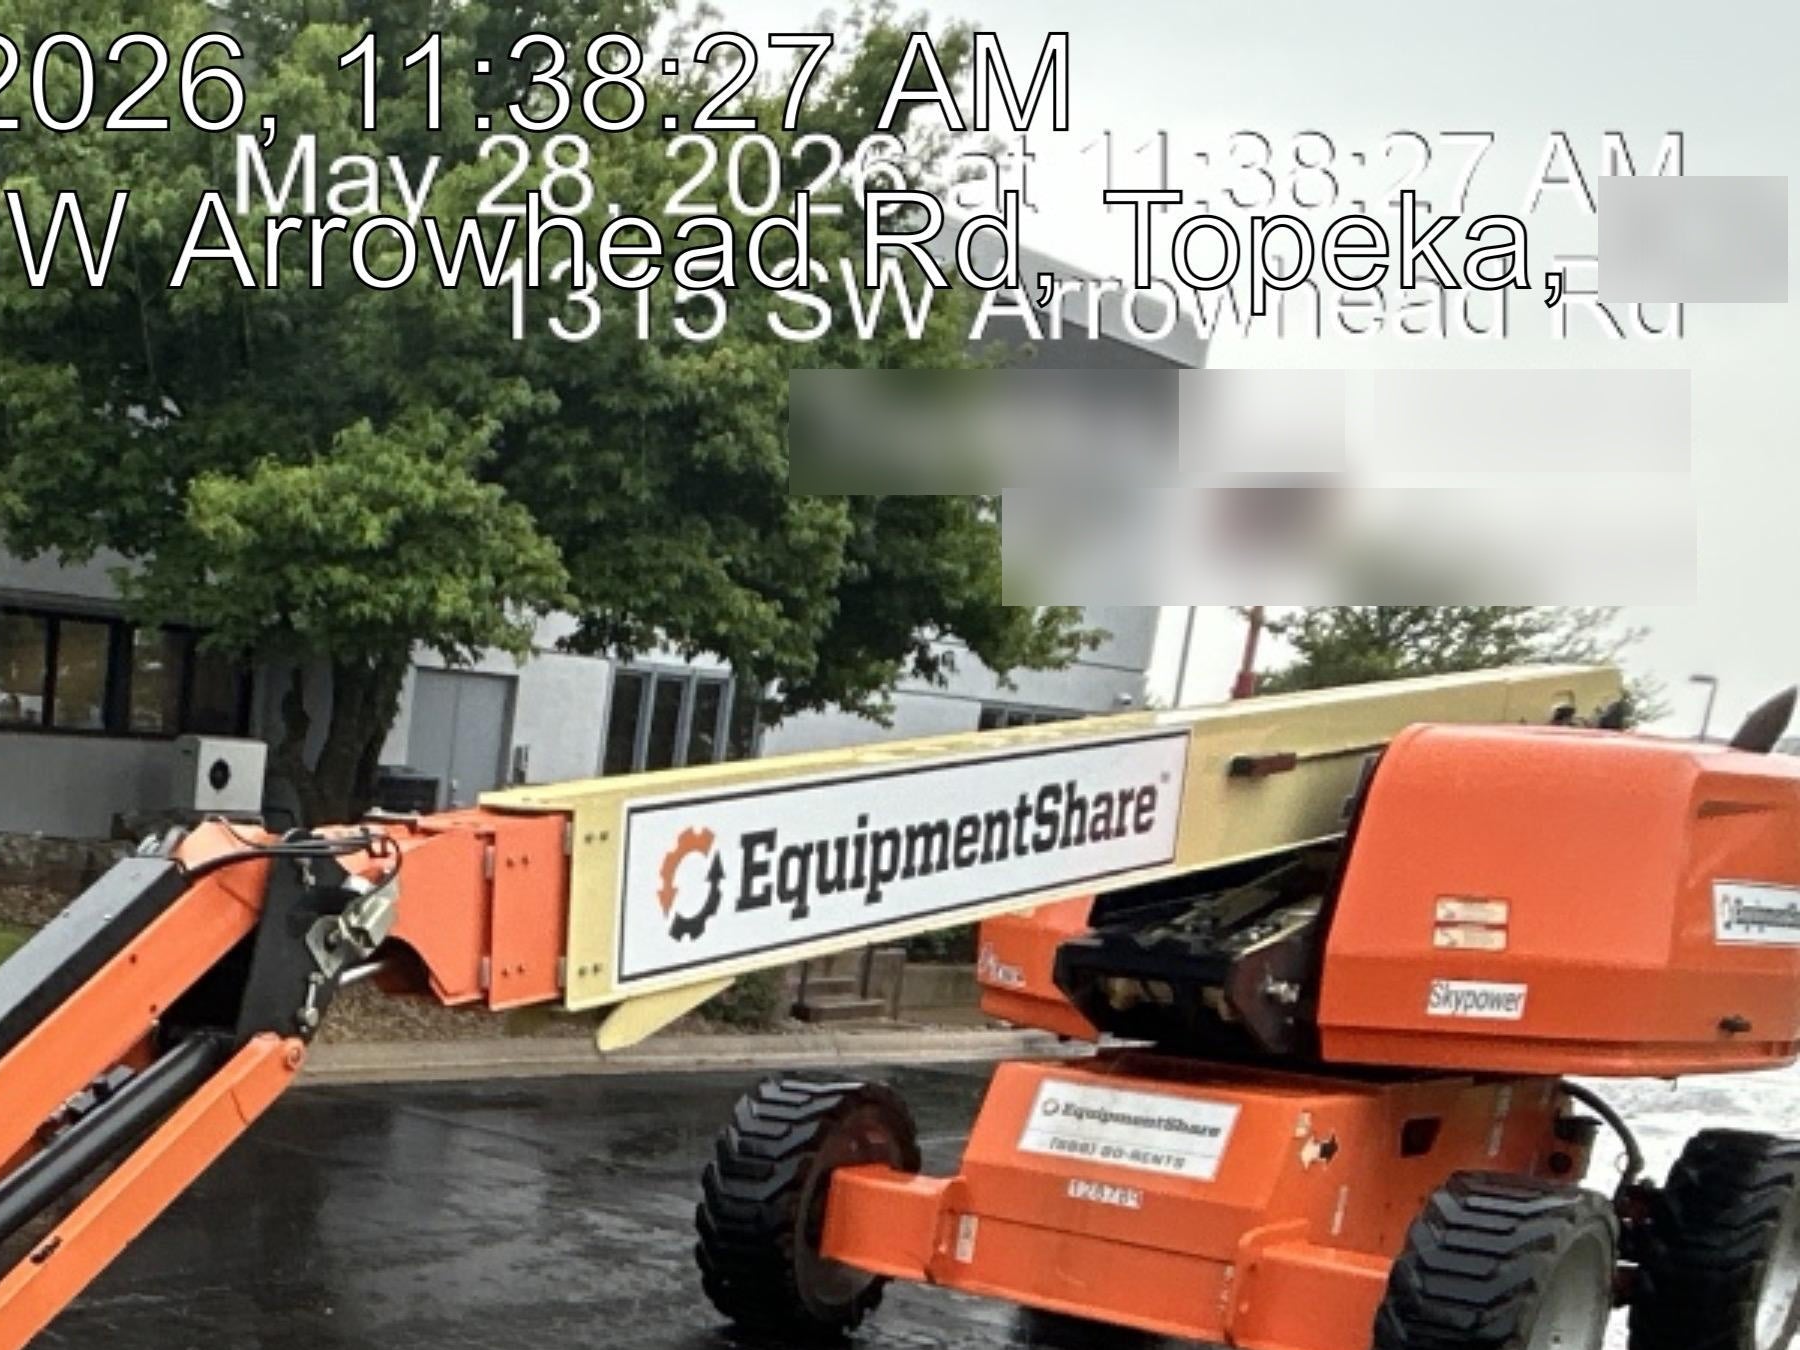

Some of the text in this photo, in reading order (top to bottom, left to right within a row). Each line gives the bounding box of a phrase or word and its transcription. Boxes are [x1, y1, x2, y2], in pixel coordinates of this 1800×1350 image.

[734, 778, 1158, 921] EquipmentShare
[1429, 981, 1525, 1016] Skypower
[1061, 1102, 1222, 1138] EquipmentShare
